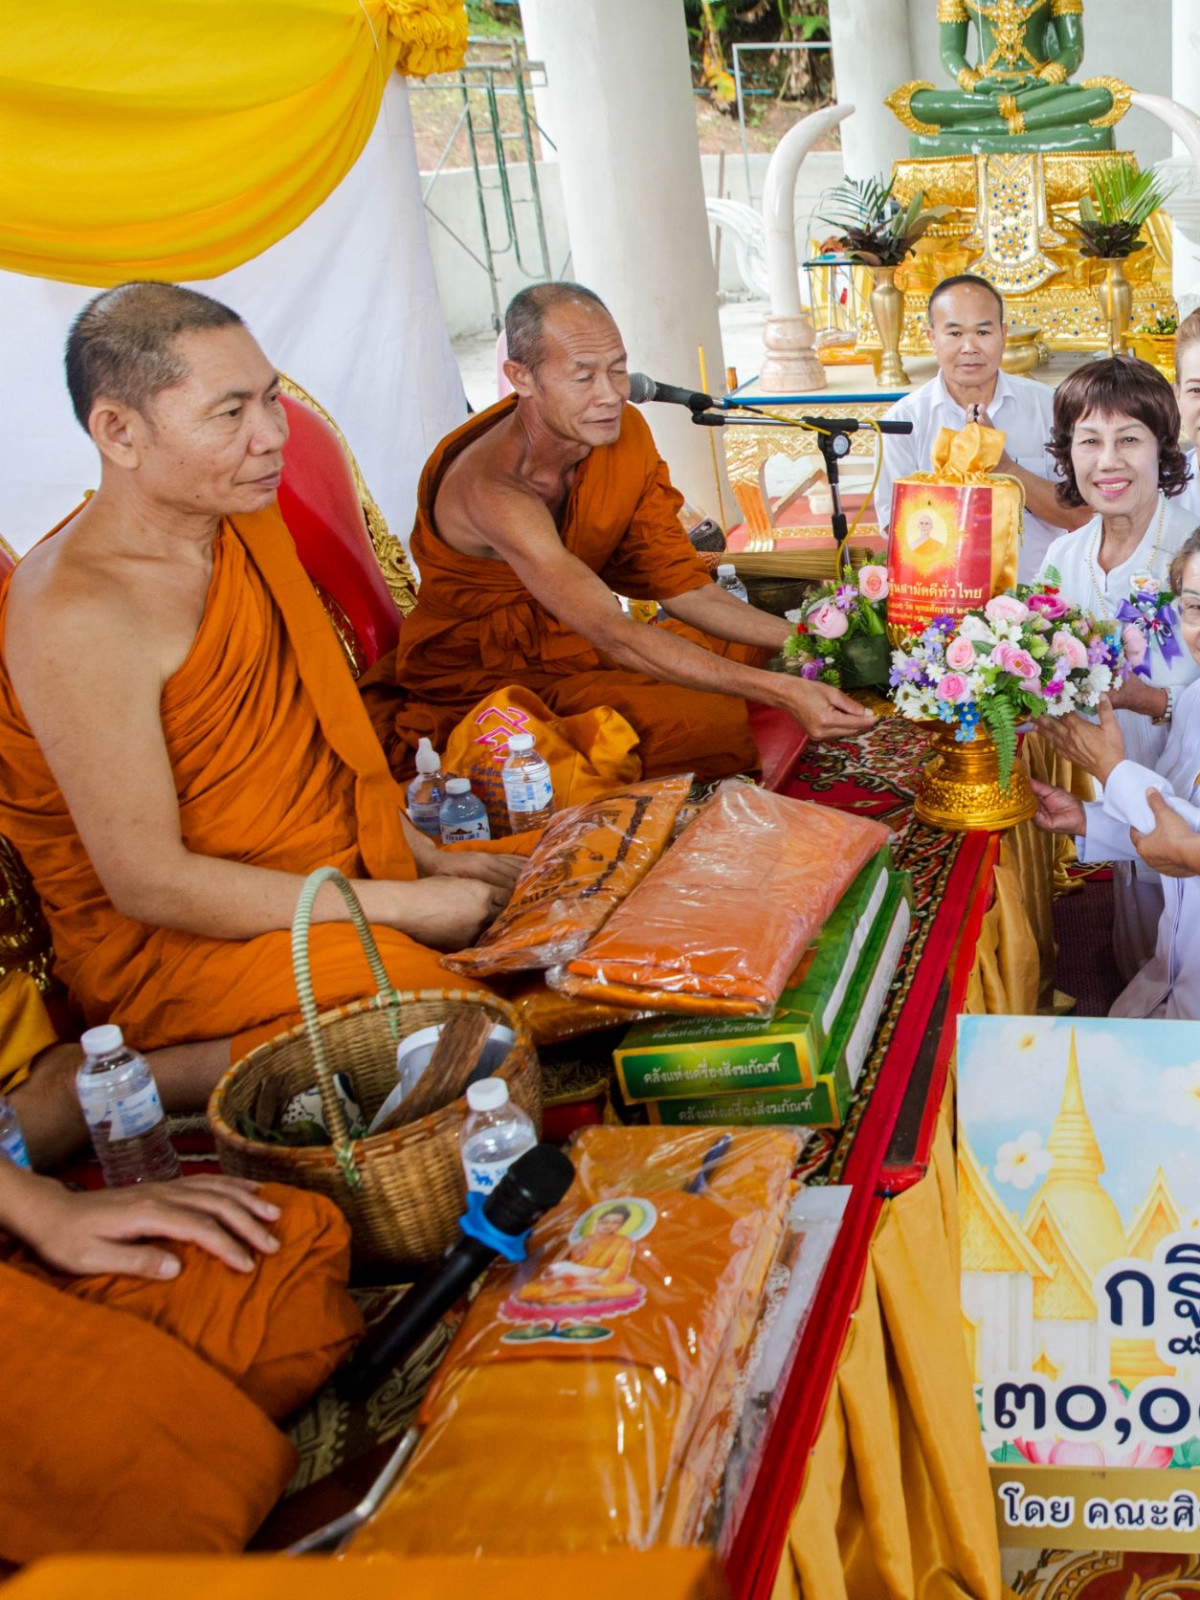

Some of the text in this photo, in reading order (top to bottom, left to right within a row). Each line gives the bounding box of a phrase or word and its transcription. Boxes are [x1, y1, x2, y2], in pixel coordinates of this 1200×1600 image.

[643, 1053, 781, 1084] คลังแห่งเครื่องสังฆภัณฑ์
[1002, 1487, 1071, 1523] โดย
